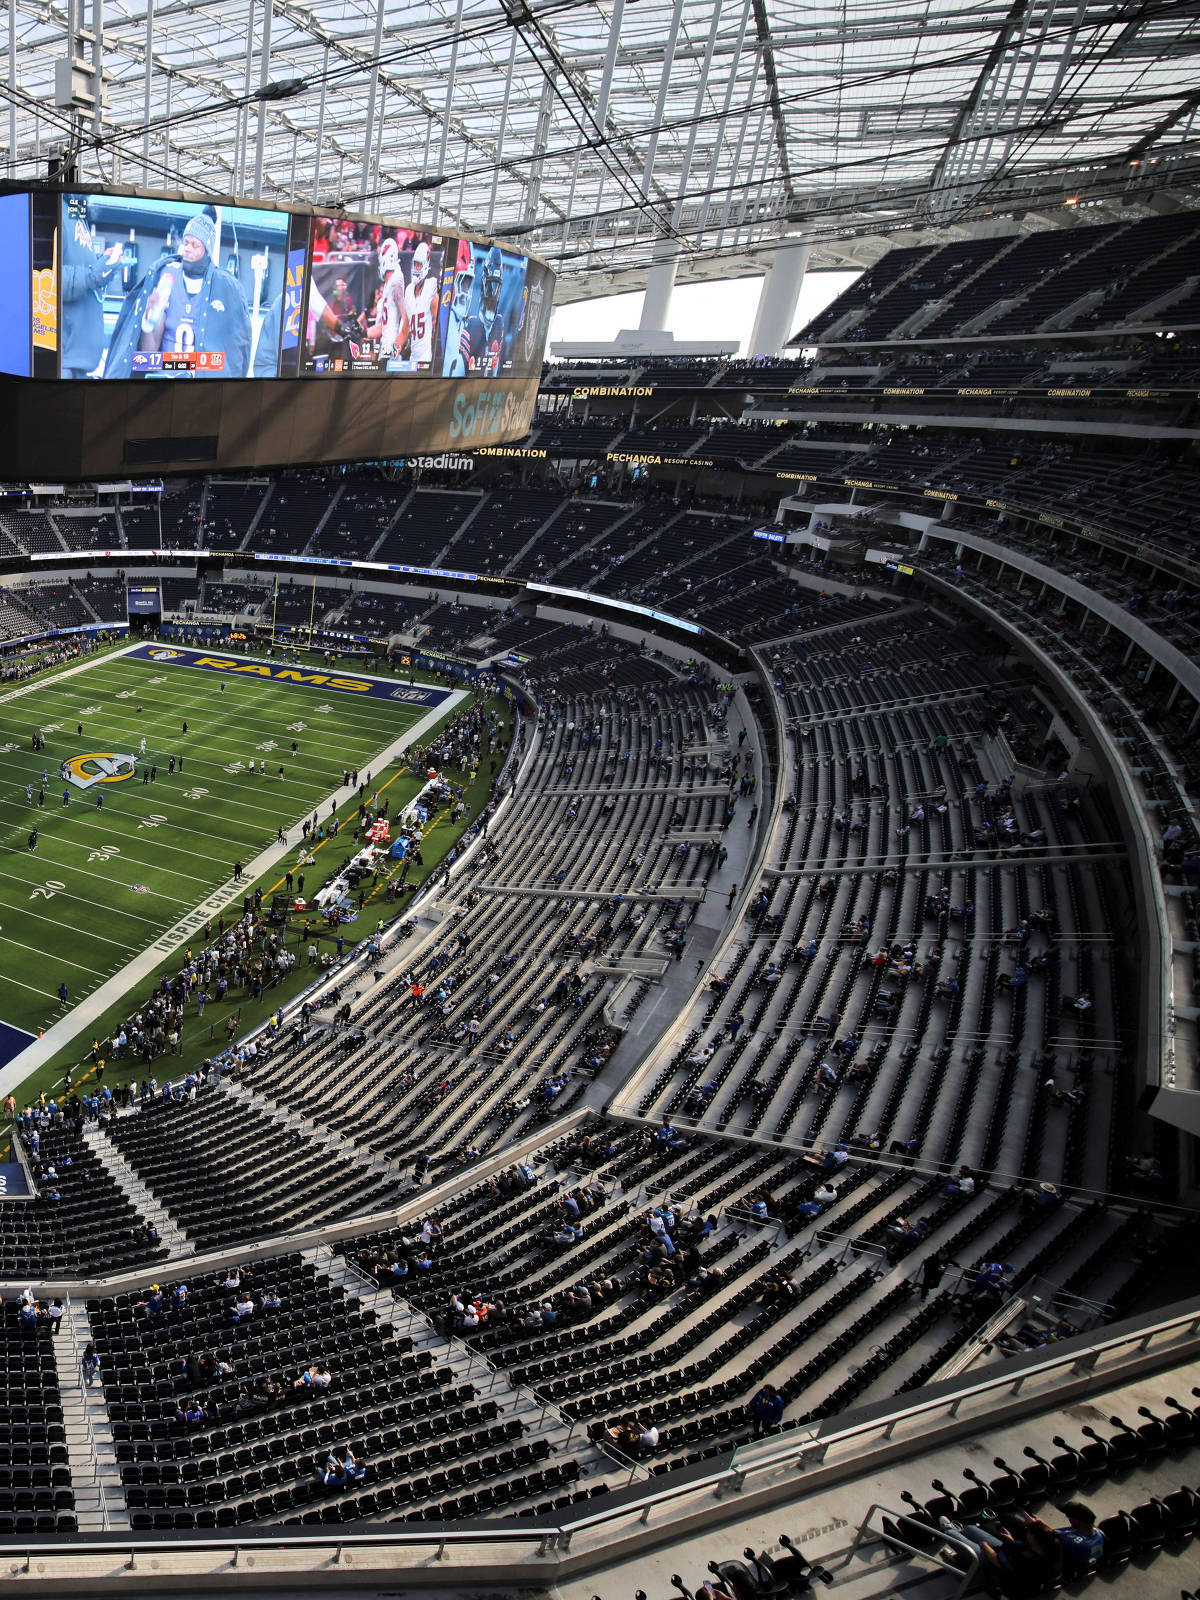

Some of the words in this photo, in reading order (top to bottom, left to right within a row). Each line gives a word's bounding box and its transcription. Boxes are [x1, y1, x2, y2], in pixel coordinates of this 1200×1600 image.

[410, 312, 425, 341] 45
[150, 354, 162, 365] 17
[200, 354, 207, 365] 0
[573, 387, 653, 397] COMBINATION
[957, 388, 992, 396] PECHANGA
[1047, 389, 1091, 397] COMBINATION
[449, 392, 490, 438] SoFi
[606, 453, 662, 465] PECHANGA
[776, 472, 817, 481] COMBINATION
[844, 479, 873, 488] PECHANGA
[923, 489, 958, 500] COMBINATION
[323, 631, 354, 640] HOUSE
[420, 650, 446, 661] PECHANGA
[193, 657, 374, 692] RAMS
[396, 691, 421, 700] NFL
[183, 787, 209, 800] 50
[139, 814, 168, 829] 40
[90, 845, 120, 862] 30
[32, 880, 66, 900] 20
[153, 910, 211, 953] INSPIRE
[205, 872, 255, 909] CHANGE
